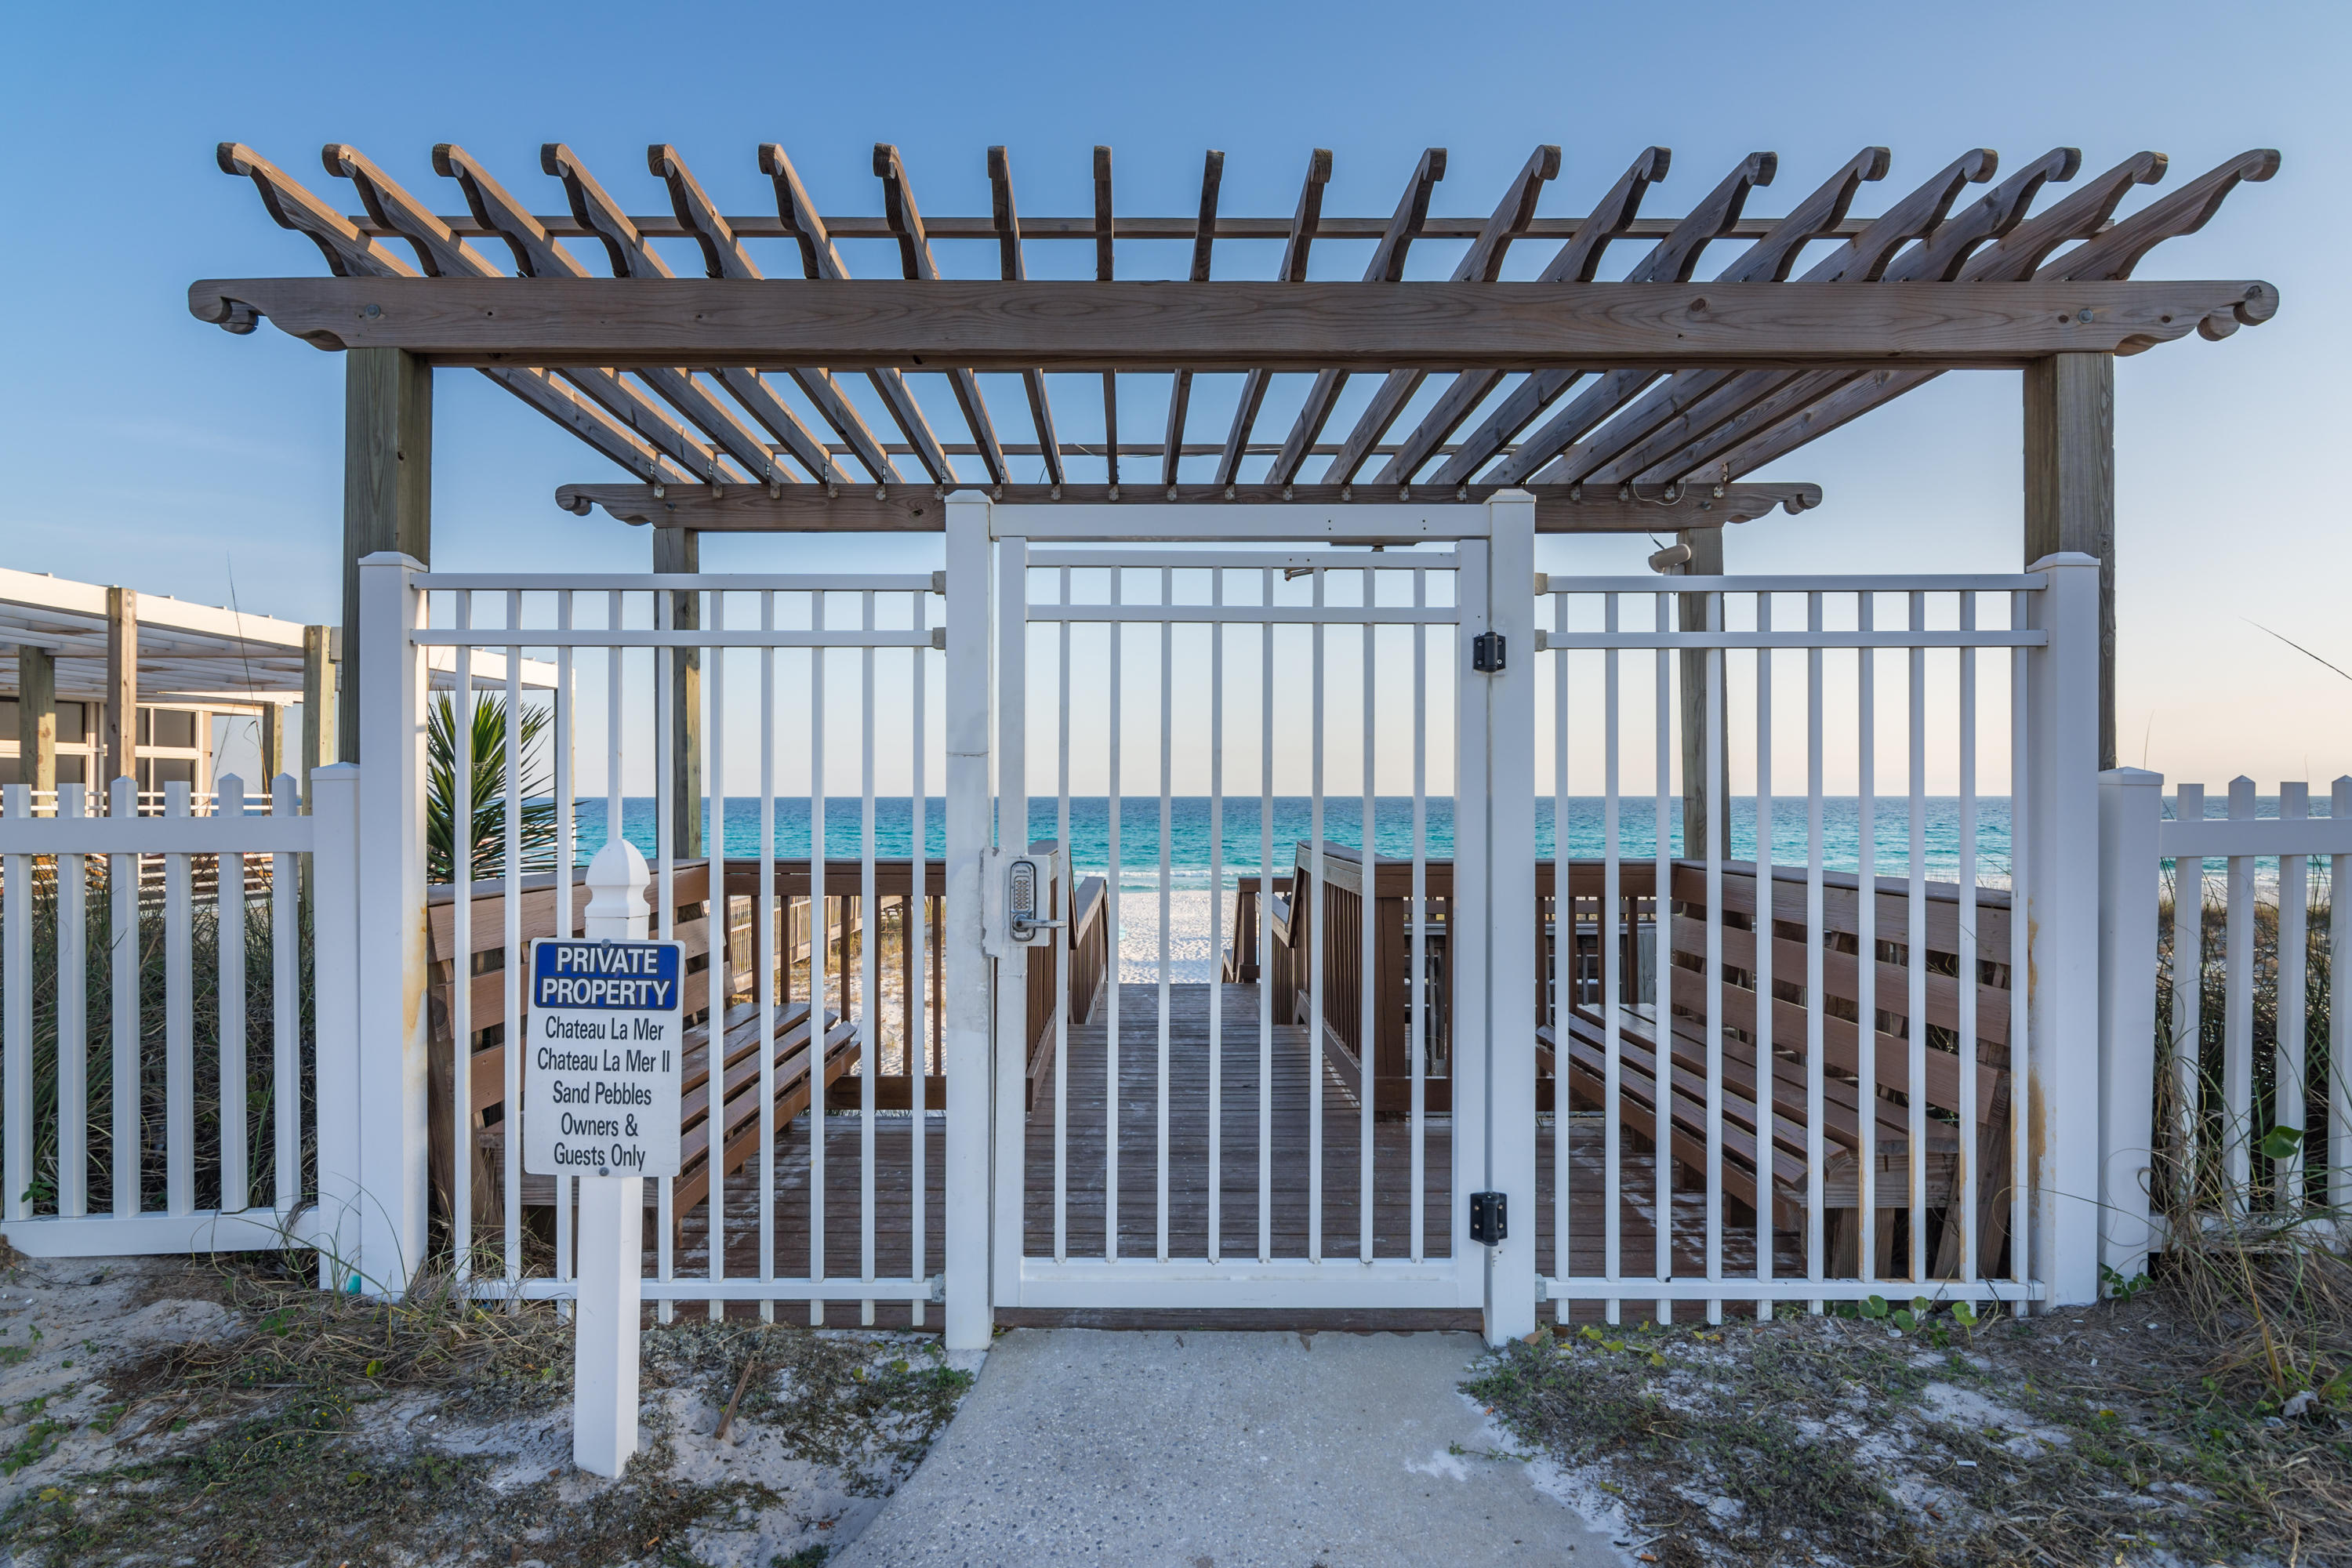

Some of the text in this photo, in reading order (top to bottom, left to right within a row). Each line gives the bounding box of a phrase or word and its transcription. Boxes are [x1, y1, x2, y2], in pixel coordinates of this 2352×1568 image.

[557, 947, 658, 974] PRIVATE
[542, 978, 670, 1005] PROPERTY
[546, 1016, 663, 1040] Chateau La Mer
[538, 1047, 670, 1073] Chateau La Mer II
[553, 1080, 652, 1105] Sand Pebbles
[561, 1112, 638, 1136] Owners &
[554, 1142, 645, 1171] Guests Only
